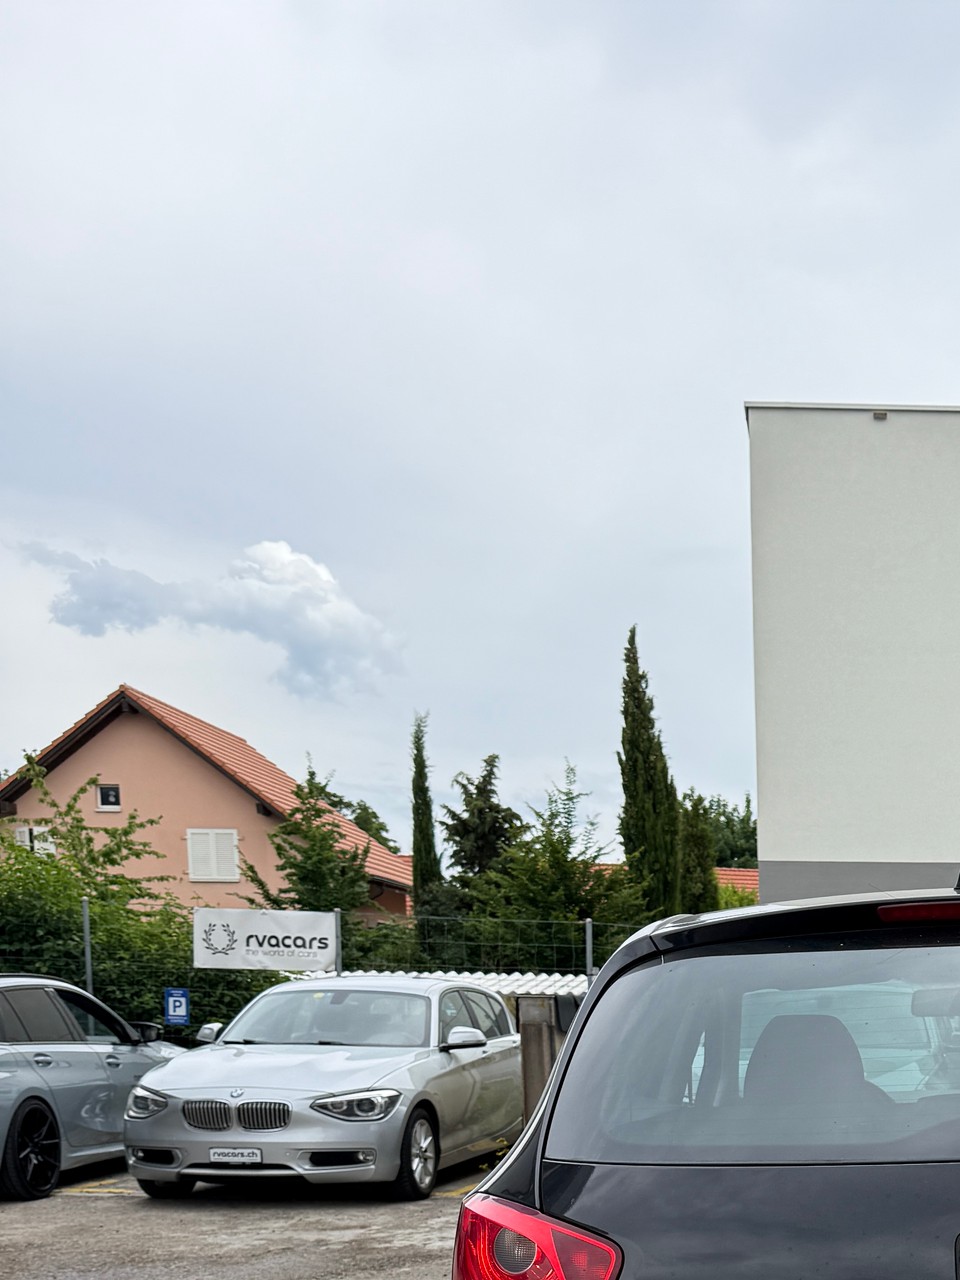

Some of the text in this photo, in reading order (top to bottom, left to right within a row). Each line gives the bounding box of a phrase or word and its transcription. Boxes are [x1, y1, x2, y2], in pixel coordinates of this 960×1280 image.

[245, 934, 329, 950] rvacars
[261, 949, 285, 957] world
[173, 999, 183, 1013] P
